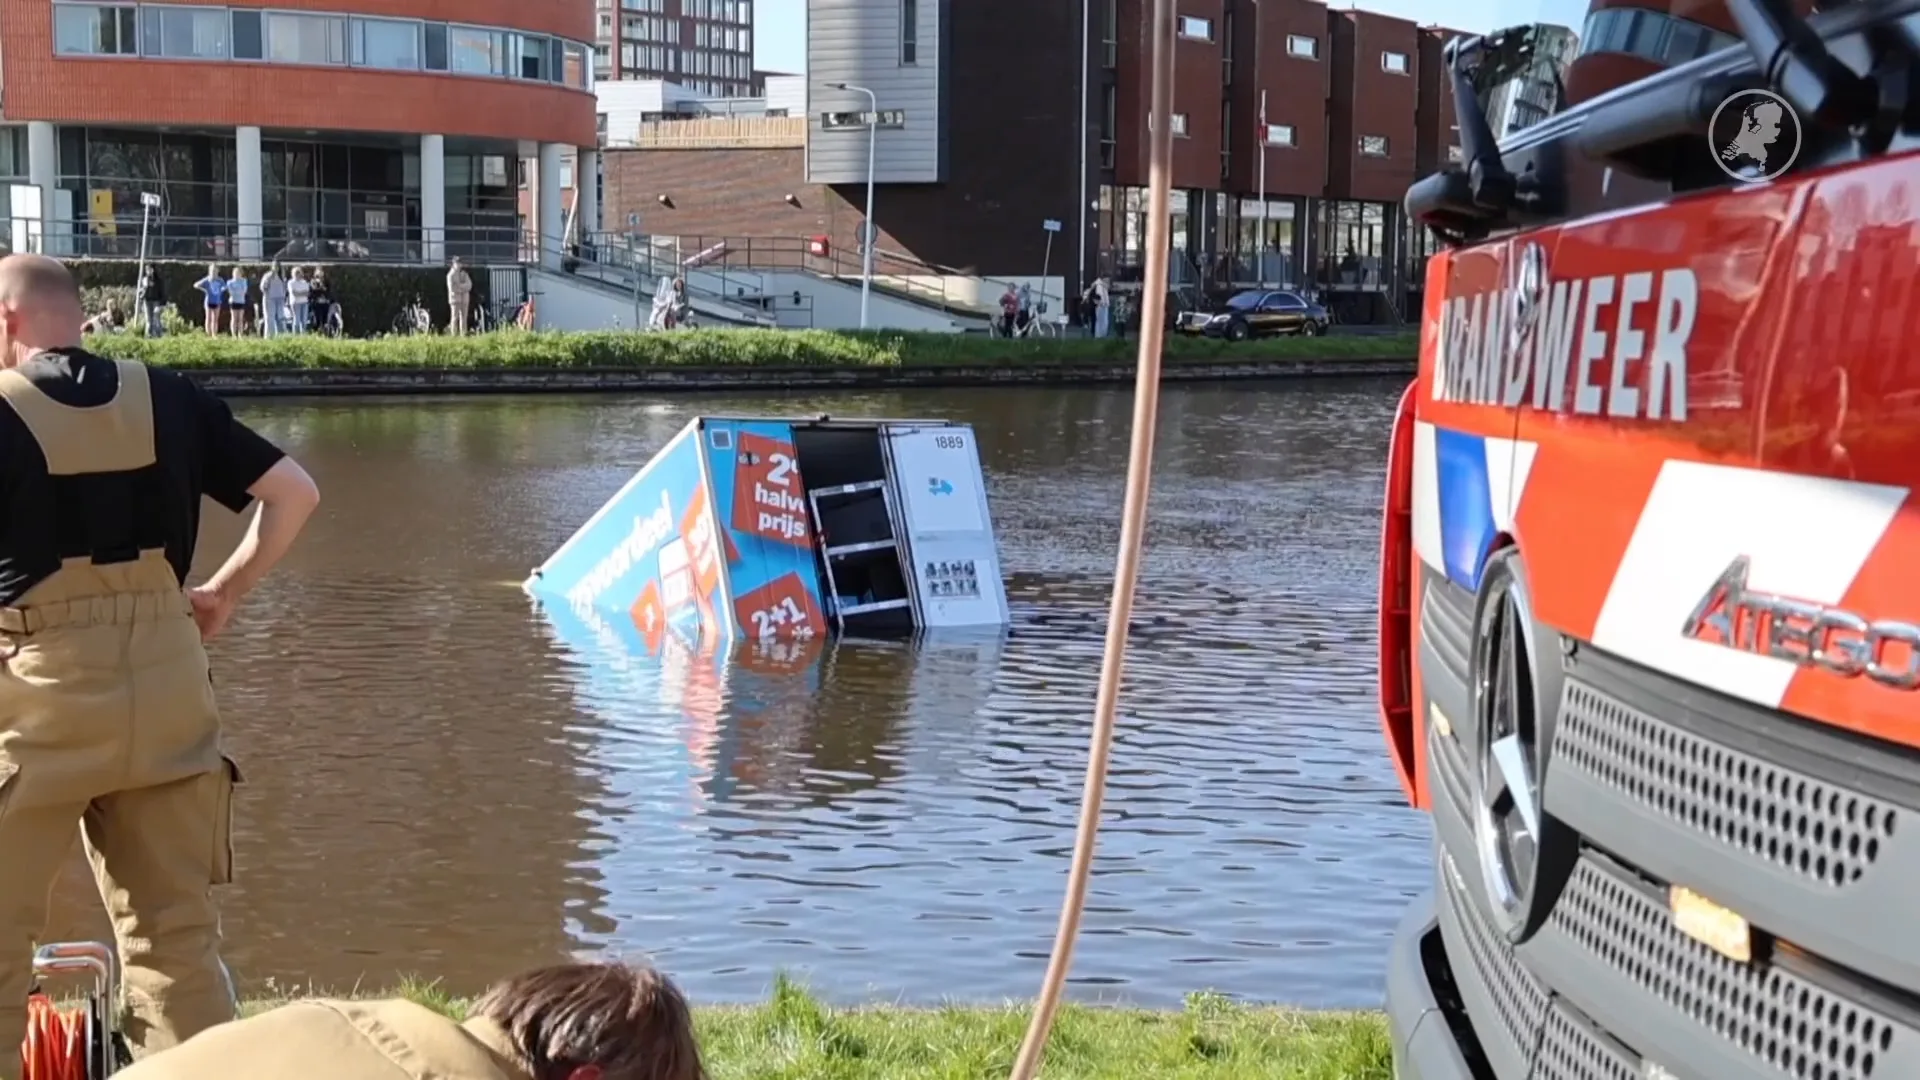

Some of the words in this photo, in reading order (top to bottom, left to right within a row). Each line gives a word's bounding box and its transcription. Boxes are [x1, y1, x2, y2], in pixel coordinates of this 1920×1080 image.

[935, 435, 964, 450] 1889
[758, 511, 805, 539] prijs
[751, 596, 806, 638] 2+1
